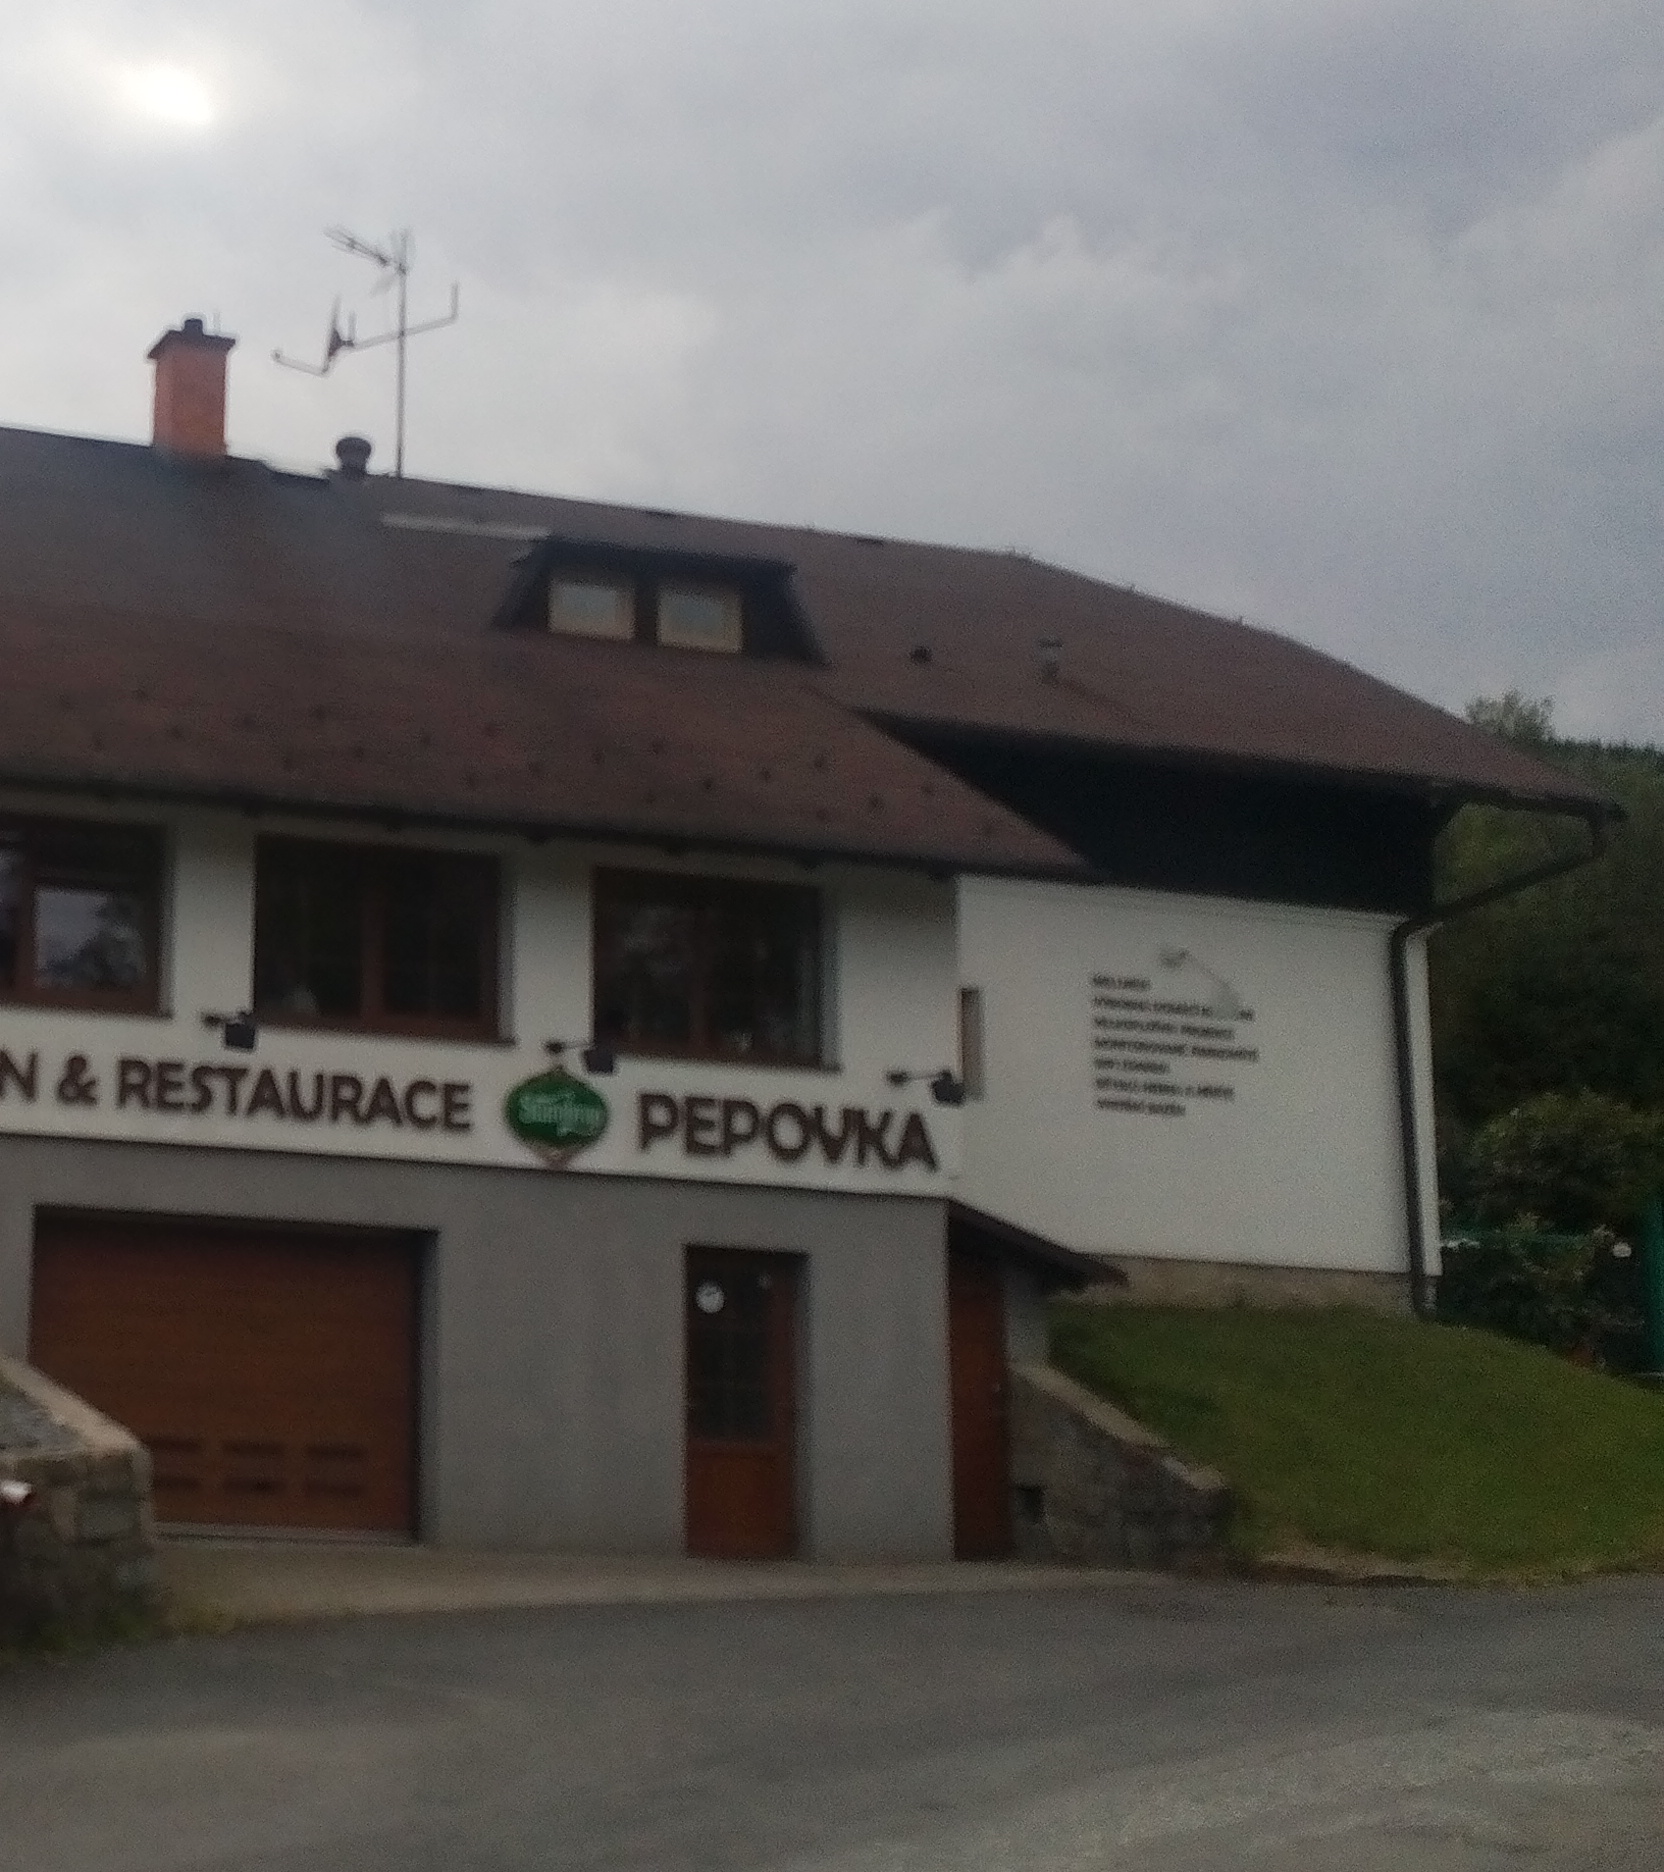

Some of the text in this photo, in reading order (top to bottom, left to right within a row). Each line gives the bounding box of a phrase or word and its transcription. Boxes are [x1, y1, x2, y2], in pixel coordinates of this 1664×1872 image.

[55, 1054, 100, 1106] &
[116, 1057, 473, 1132] RESTAURACE
[640, 1091, 938, 1172] PEPOVKA
